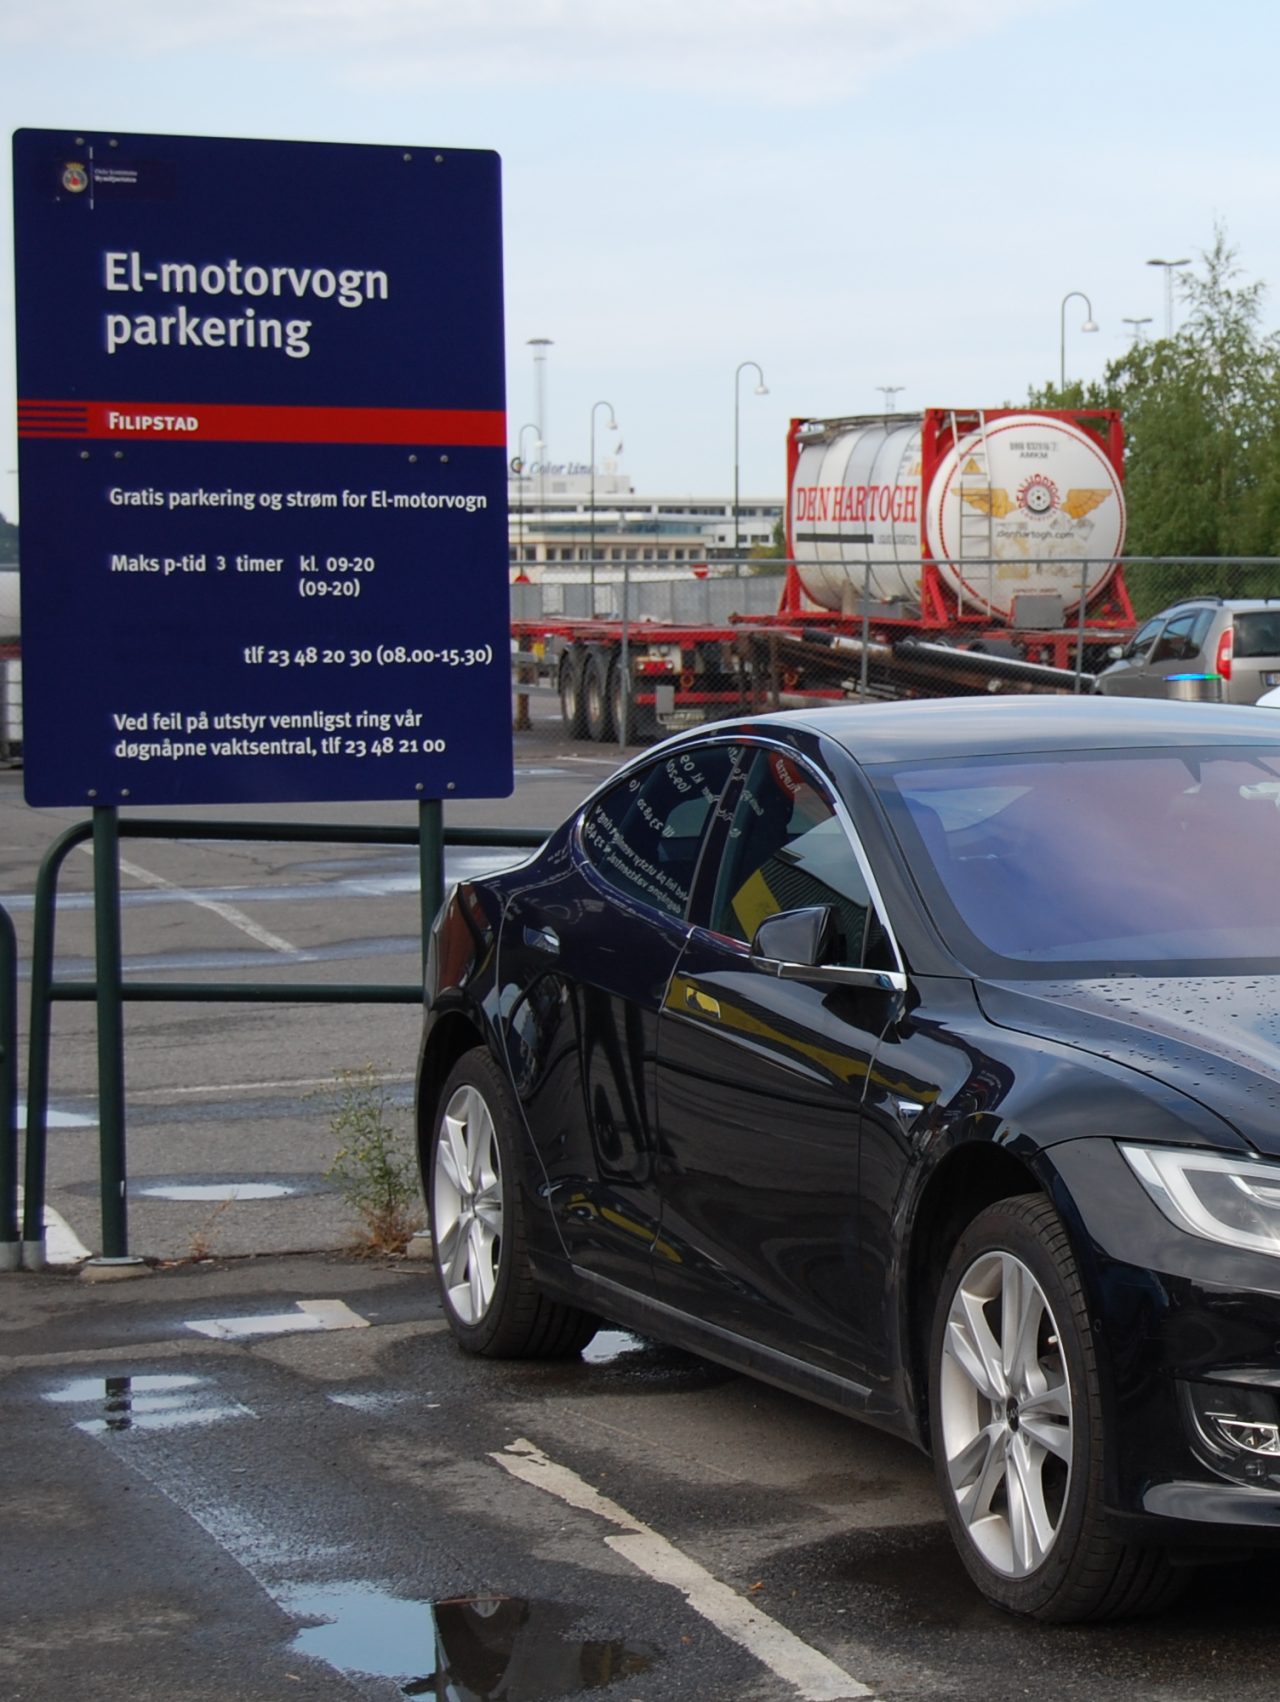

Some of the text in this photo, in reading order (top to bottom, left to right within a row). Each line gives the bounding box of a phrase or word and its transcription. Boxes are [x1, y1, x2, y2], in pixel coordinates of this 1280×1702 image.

[105, 252, 388, 307] El-motorvogn
[106, 305, 312, 358] parkering
[109, 488, 487, 512] Gratis parkering og strøm for El-motorvogn
[796, 485, 918, 523] DEN HARTOGH
[111, 555, 284, 575] Maks p-tid 3 timer
[326, 557, 375, 572] 09-20
[299, 578, 361, 598] (09-20)
[244, 645, 493, 667] tlf 23 48 20 30 (08.00-15.30)
[113, 708, 423, 734] Ved feil på utstyr vennligst ring vår
[114, 737, 446, 761] døgnåpne vaktsentral, tlf 23 48 21 00
